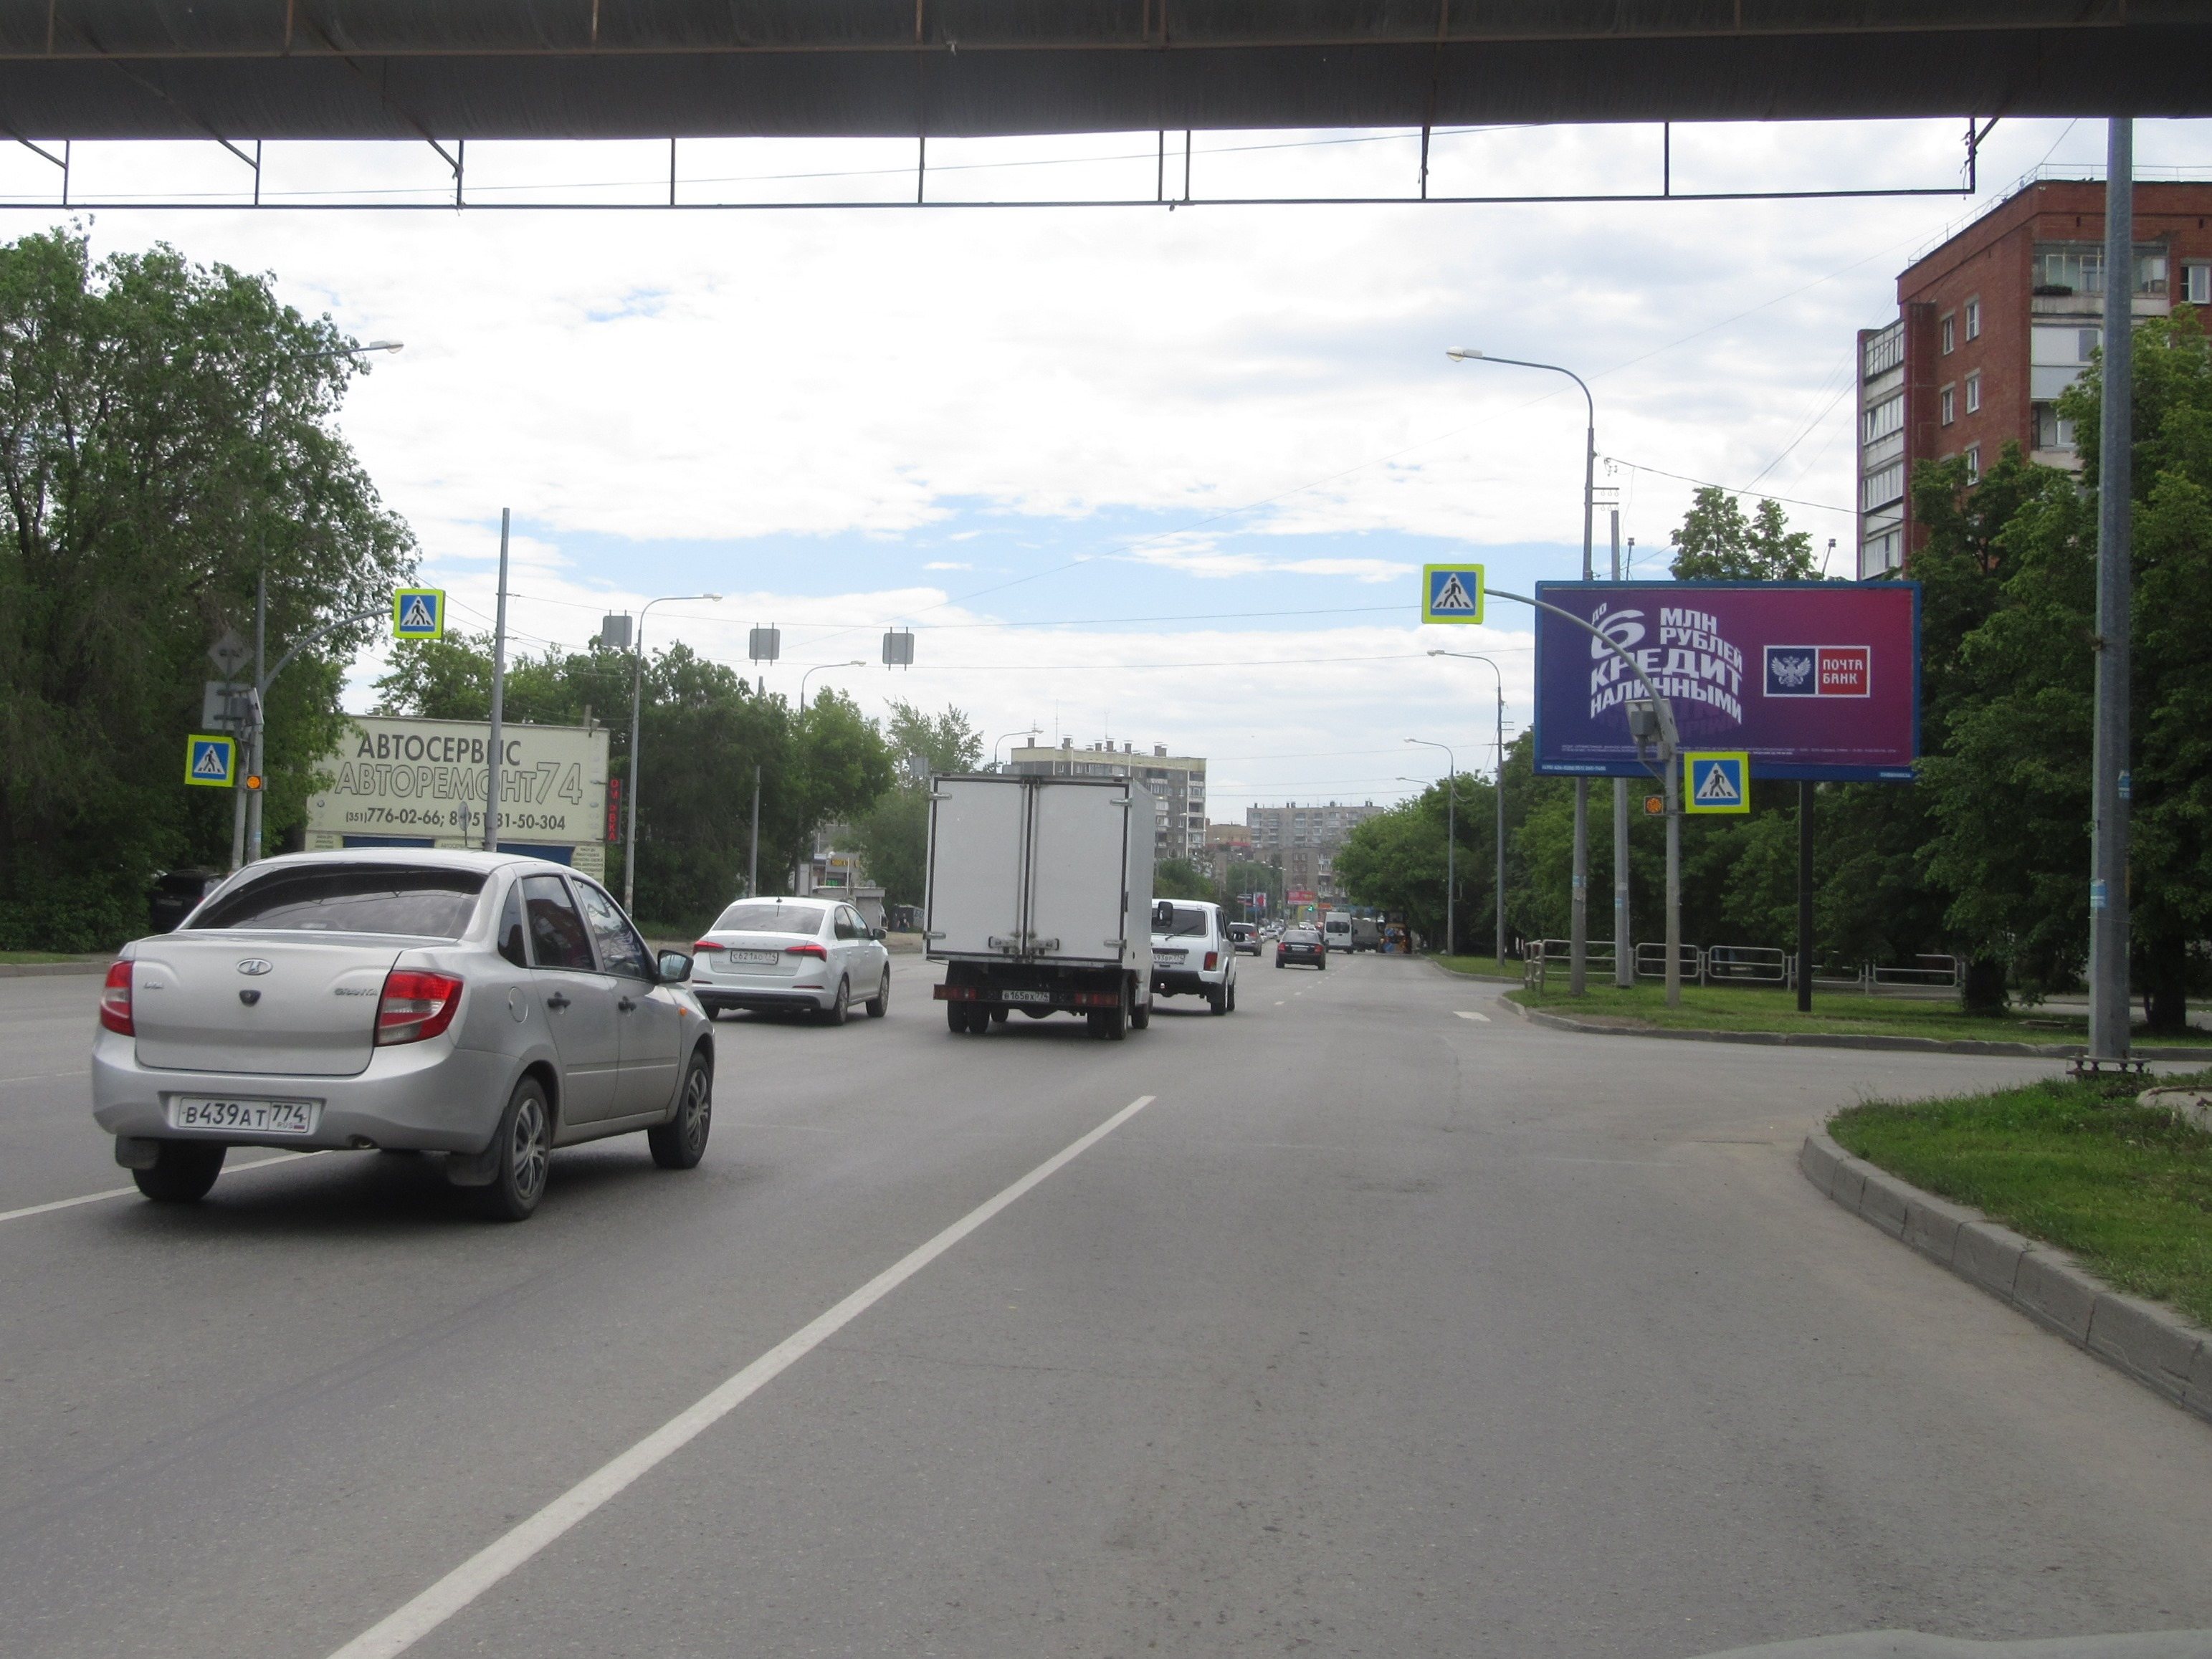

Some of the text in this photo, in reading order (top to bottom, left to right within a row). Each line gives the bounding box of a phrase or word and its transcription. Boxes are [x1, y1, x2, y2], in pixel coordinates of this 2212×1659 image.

[1591, 608, 1717, 659] 6 МЛН
[1660, 627, 1743, 674] РУБЛЕЙ
[1591, 648, 1743, 696] КРЕДИТ
[1823, 659, 1863, 671] ПОЧТА
[1823, 673, 1858, 684] БАНК
[1591, 677, 1742, 725] НАЛИЧНЫМИ
[272, 1104, 304, 1123] 774
